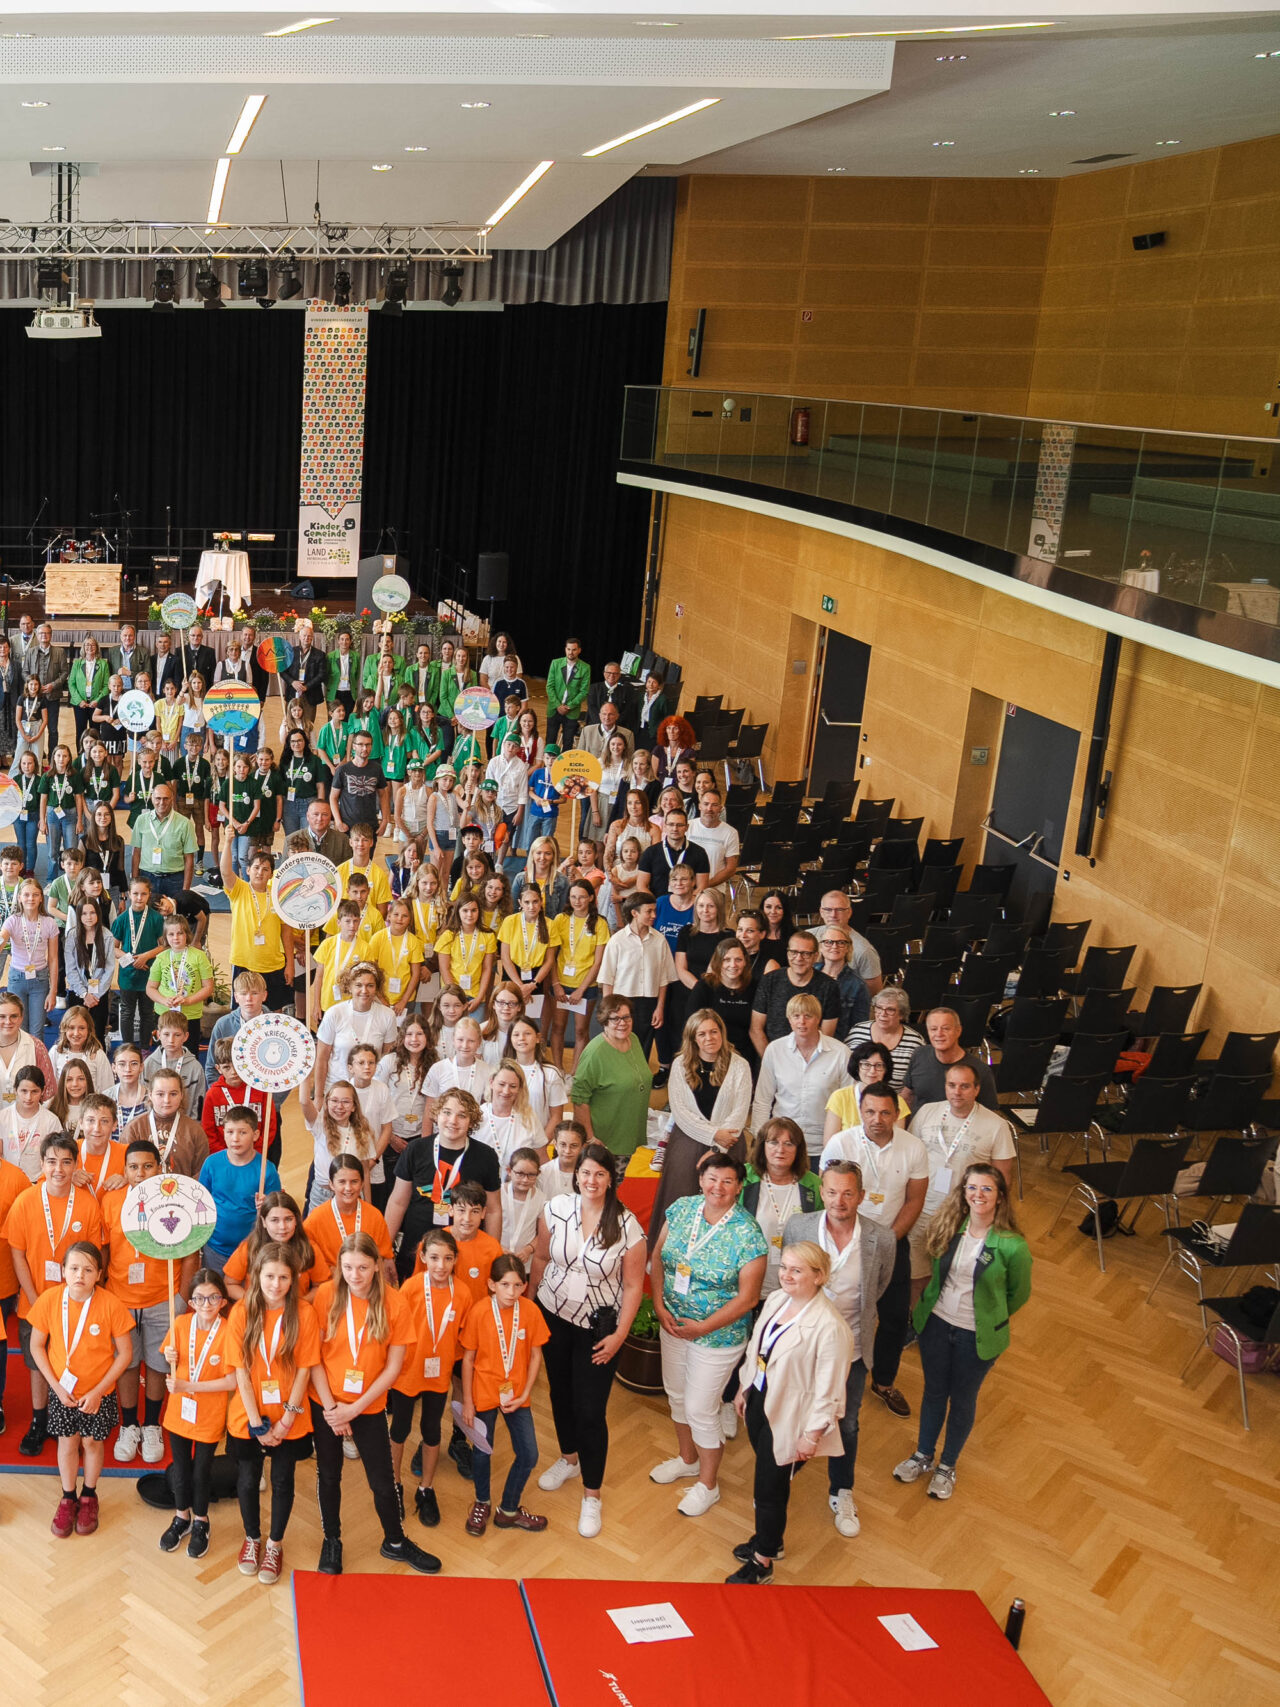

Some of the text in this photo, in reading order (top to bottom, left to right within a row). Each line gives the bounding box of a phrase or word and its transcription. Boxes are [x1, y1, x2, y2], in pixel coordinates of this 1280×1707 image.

[310, 522, 340, 530] Kinder
[303, 530, 347, 538] Gemeinde
[307, 537, 322, 545] Rat
[307, 548, 326, 556] LAND
[275, 855, 338, 880] Kindergemeinderat
[264, 1030, 298, 1058] KRIEGLACHER
[249, 1035, 295, 1076] KINDERGEMEINDERAT
